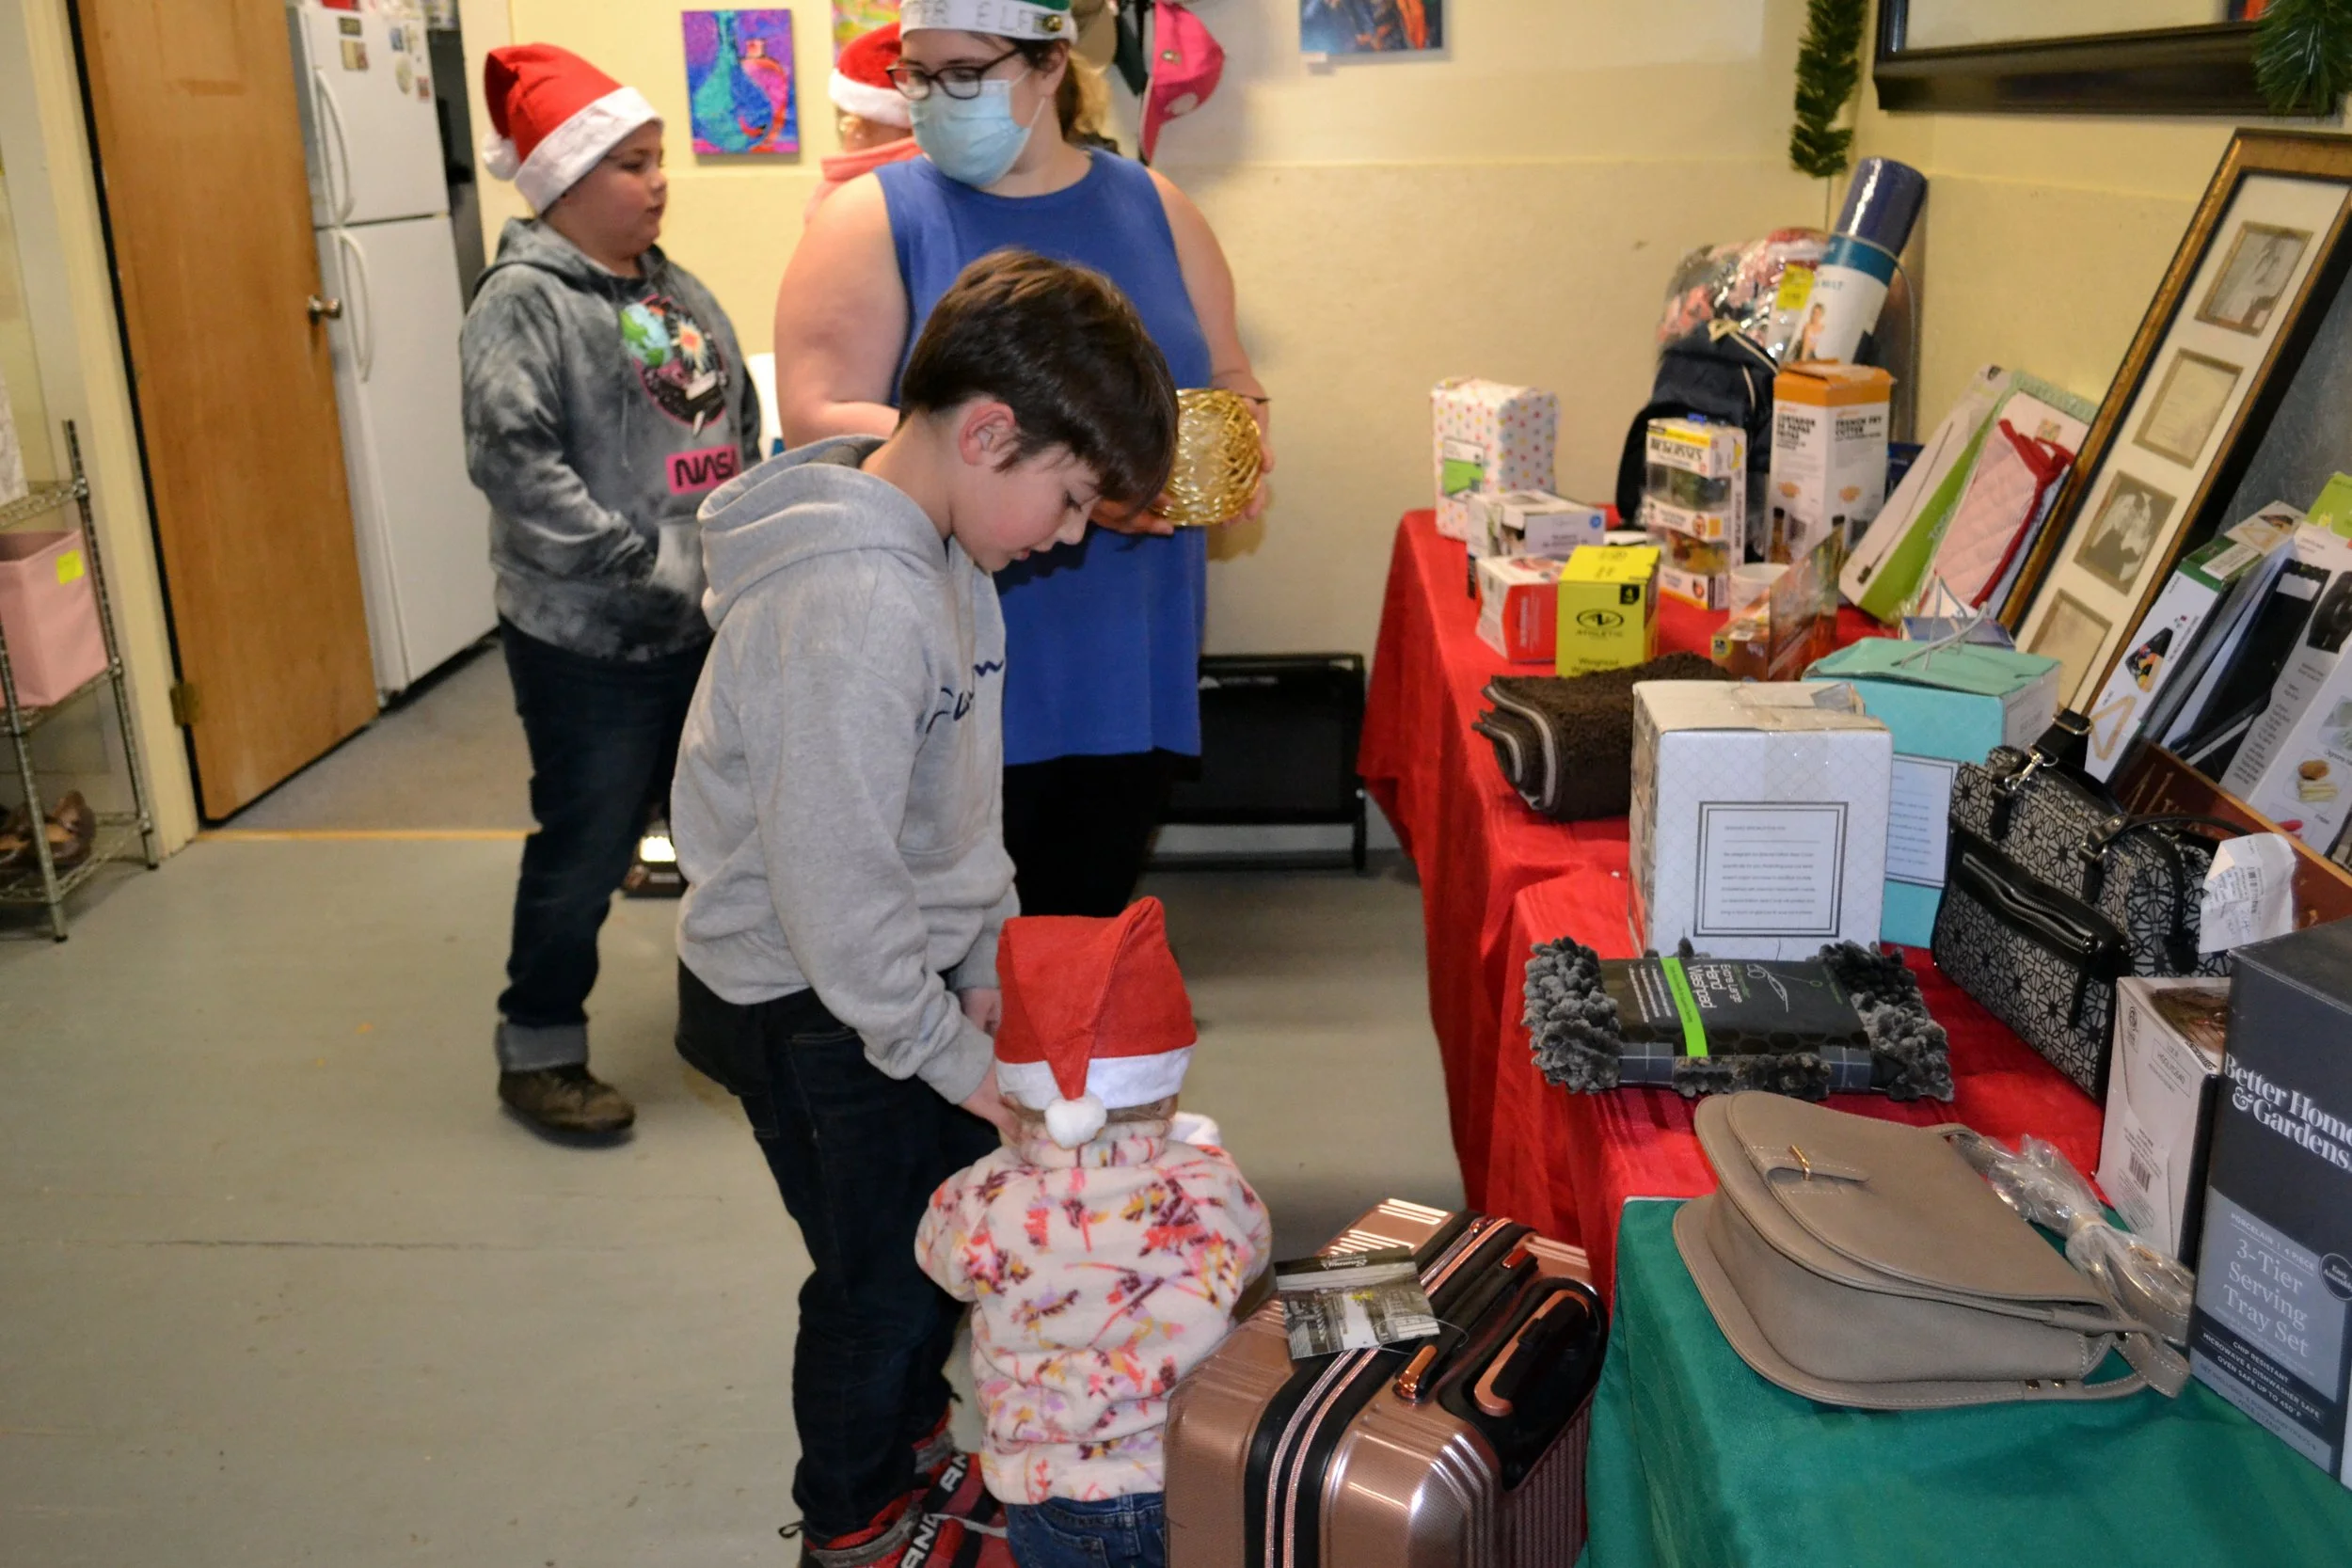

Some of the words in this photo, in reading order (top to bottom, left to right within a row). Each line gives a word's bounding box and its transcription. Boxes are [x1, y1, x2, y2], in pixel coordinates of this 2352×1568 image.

[976, 2, 1031, 32] ELF
[1687, 964, 1718, 1008] Washpad
[1704, 964, 1727, 990] Hand
[2224, 1052, 2287, 1107] Better
[2231, 1212, 2274, 1245] PORCELAIN
[2291, 1251, 2315, 1272] PIECE
[2236, 1238, 2303, 1294] 3-Tier
[2223, 1284, 2271, 1332] Tray
[2274, 1320, 2310, 1358] Set
[2228, 1260, 2309, 1332] Serving
[2202, 1332, 2246, 1366] MICROWAVE
[2252, 1367, 2299, 1404] DISHWASHER
[2301, 1400, 2321, 1419] SAFE
[2217, 1355, 2236, 1373] OVEN
[2238, 1370, 2256, 1386] SAFE
[2257, 1383, 2267, 1393] UP
[2268, 1391, 2279, 1402] TO
[2233, 1340, 2249, 1356] CHIP
[2250, 1353, 2289, 1384] RESISTANT
